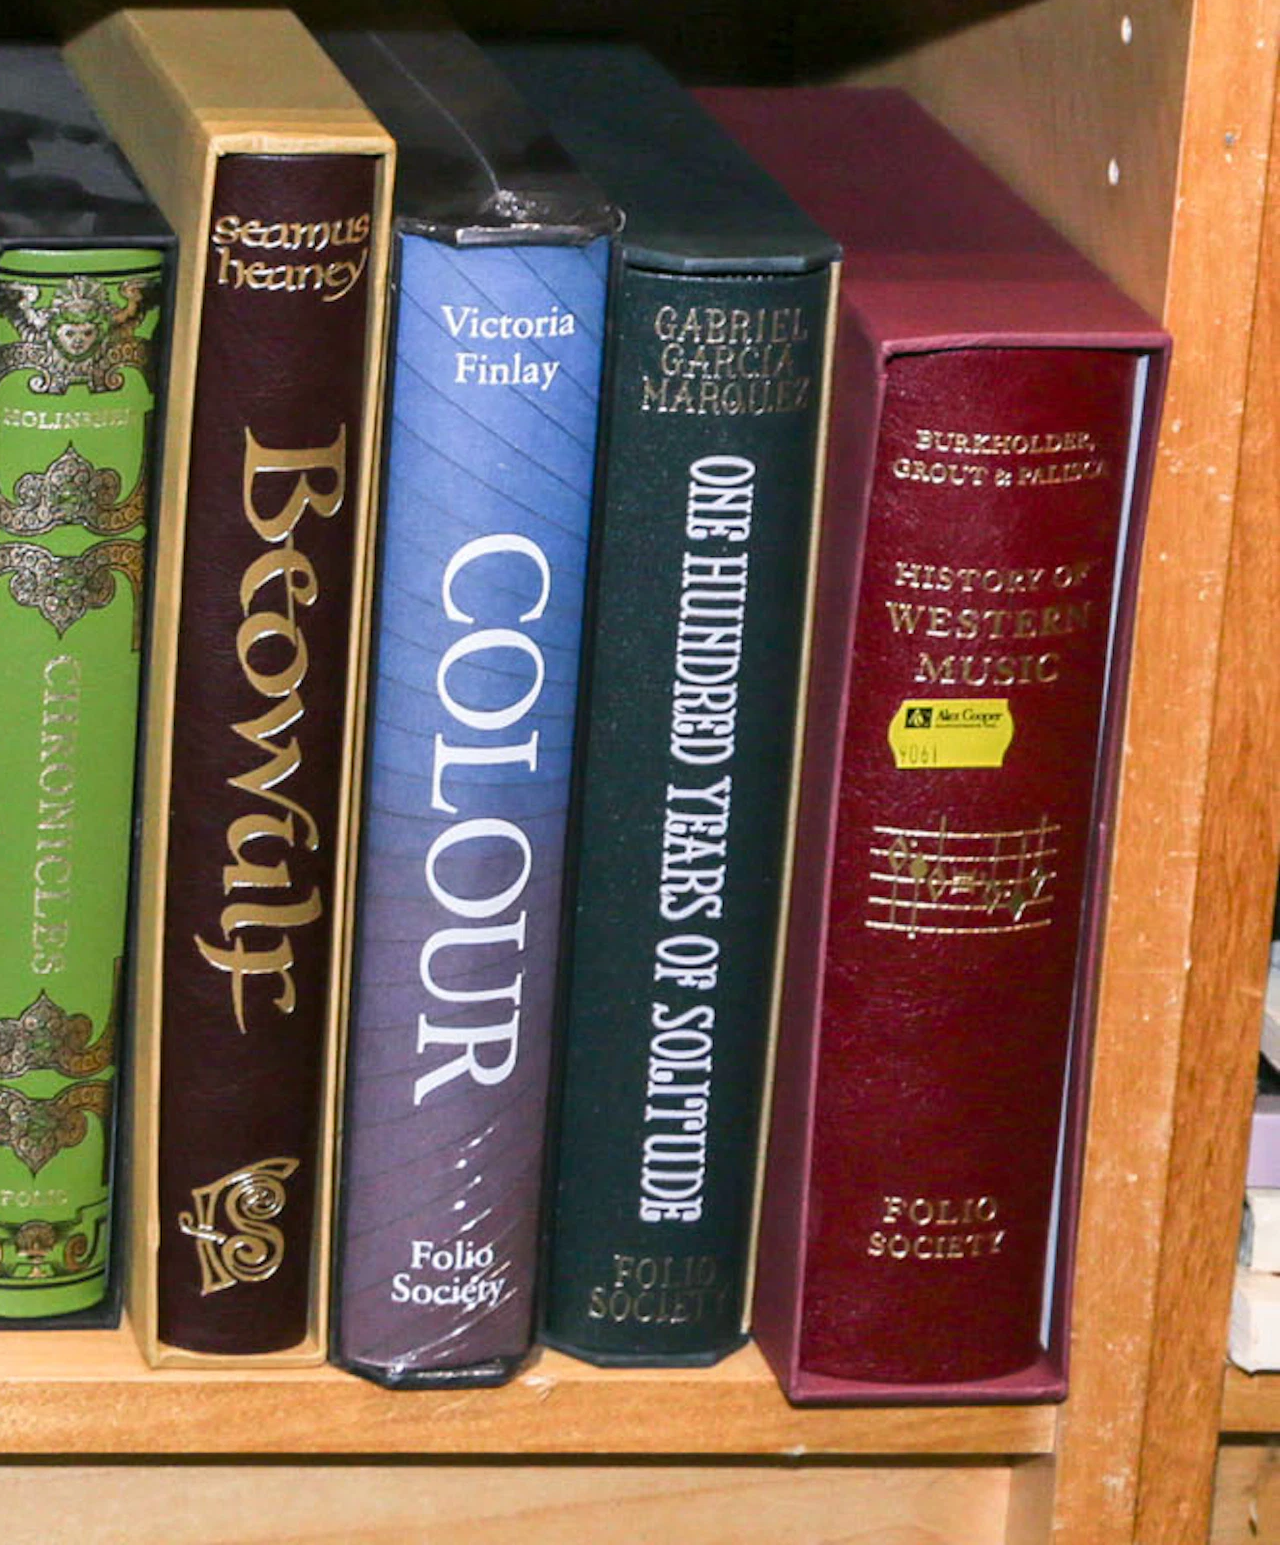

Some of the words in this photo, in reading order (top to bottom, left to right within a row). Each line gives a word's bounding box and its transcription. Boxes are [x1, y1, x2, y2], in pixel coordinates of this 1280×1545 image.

[212, 210, 371, 253] seamus
[215, 244, 370, 304] heaney
[439, 304, 577, 340] Victoria
[654, 304, 810, 345] GABRIEL
[453, 352, 561, 391] Finlay
[892, 457, 989, 486] GROUT
[995, 465, 1013, 488] &
[686, 453, 757, 542] ONE
[894, 560, 1046, 593] HISTORY
[1052, 560, 1092, 590] OF
[885, 600, 1095, 641] WESTERN
[670, 552, 750, 766] HUNDRED
[913, 651, 1061, 689] MUSIC
[193, 421, 347, 1035] Beowulf
[30, 654, 82, 977] CHRONICLES
[412, 532, 553, 1107] COLOUR
[657, 774, 733, 922] YEARS
[652, 933, 721, 990] OF
[639, 1001, 717, 1224] SOLITUDE
[881, 1195, 998, 1226] FOLIO
[410, 1239, 495, 1272] Folio
[866, 1229, 1008, 1260] SOCIETY
[390, 1273, 507, 1307] Society
[614, 1254, 718, 1290] FOLIO
